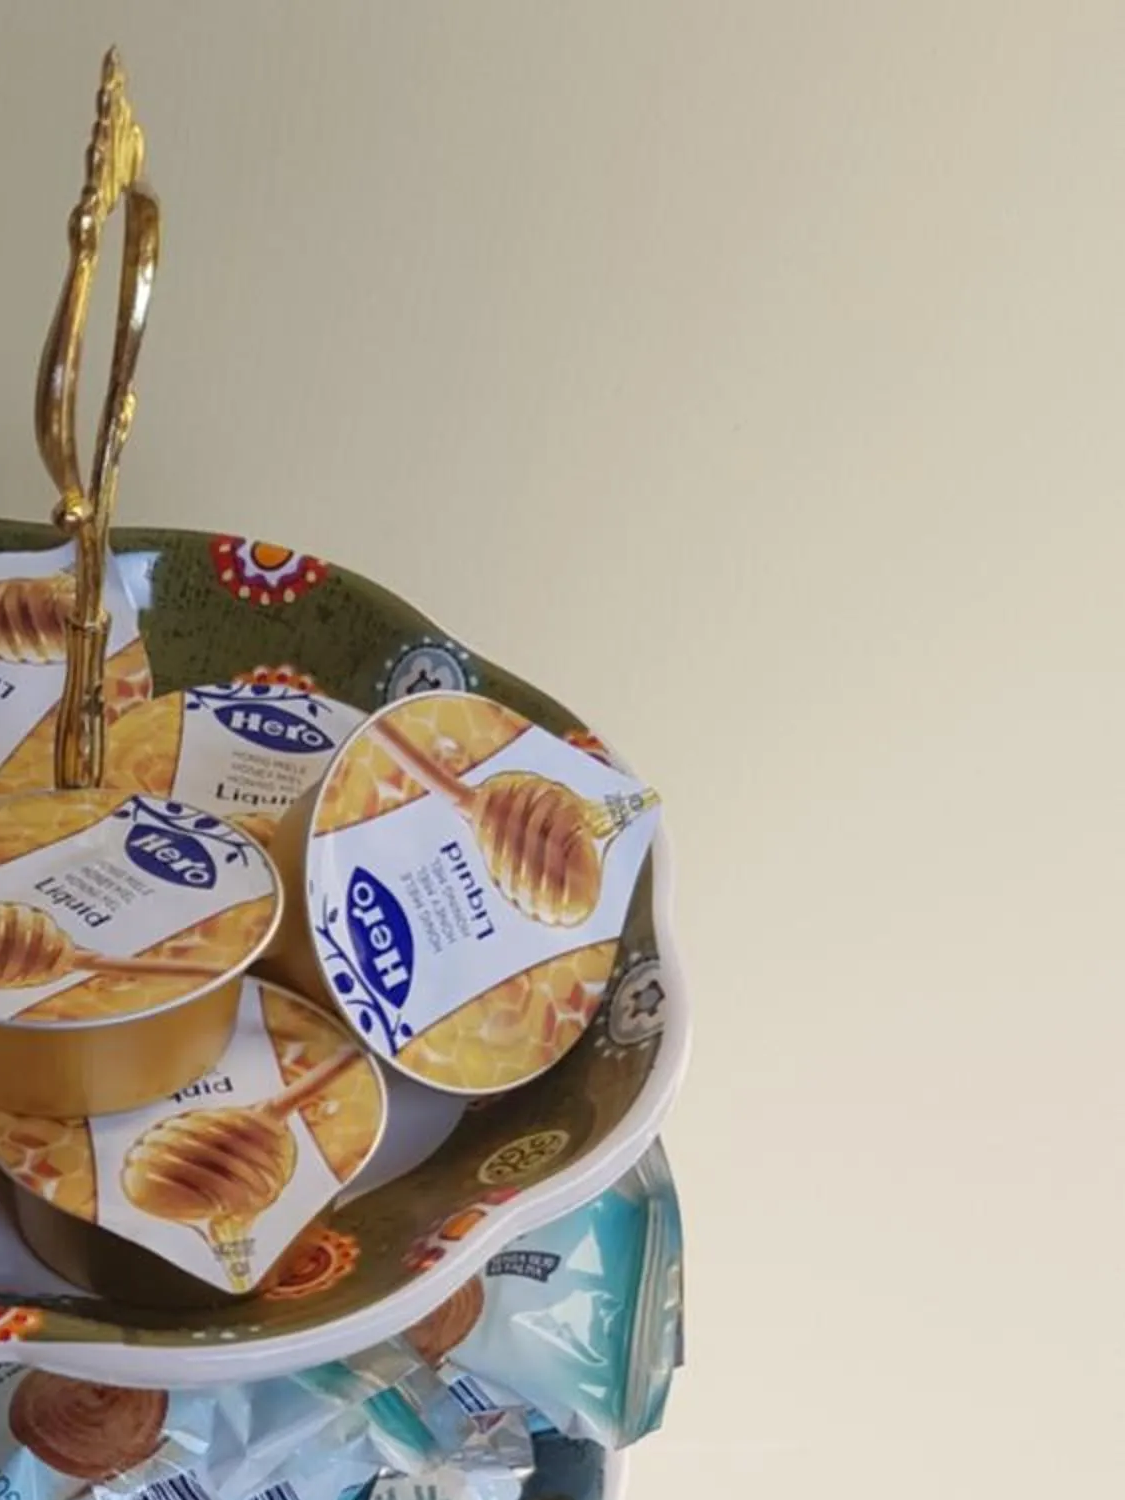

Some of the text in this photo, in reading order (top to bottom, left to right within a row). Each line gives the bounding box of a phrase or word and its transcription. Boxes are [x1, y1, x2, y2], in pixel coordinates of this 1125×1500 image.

[230, 710, 324, 747] Hero
[131, 832, 211, 884] Hero
[34, 876, 113, 928] Liquid
[440, 841, 495, 940] Liquid
[352, 880, 409, 990] Hero
